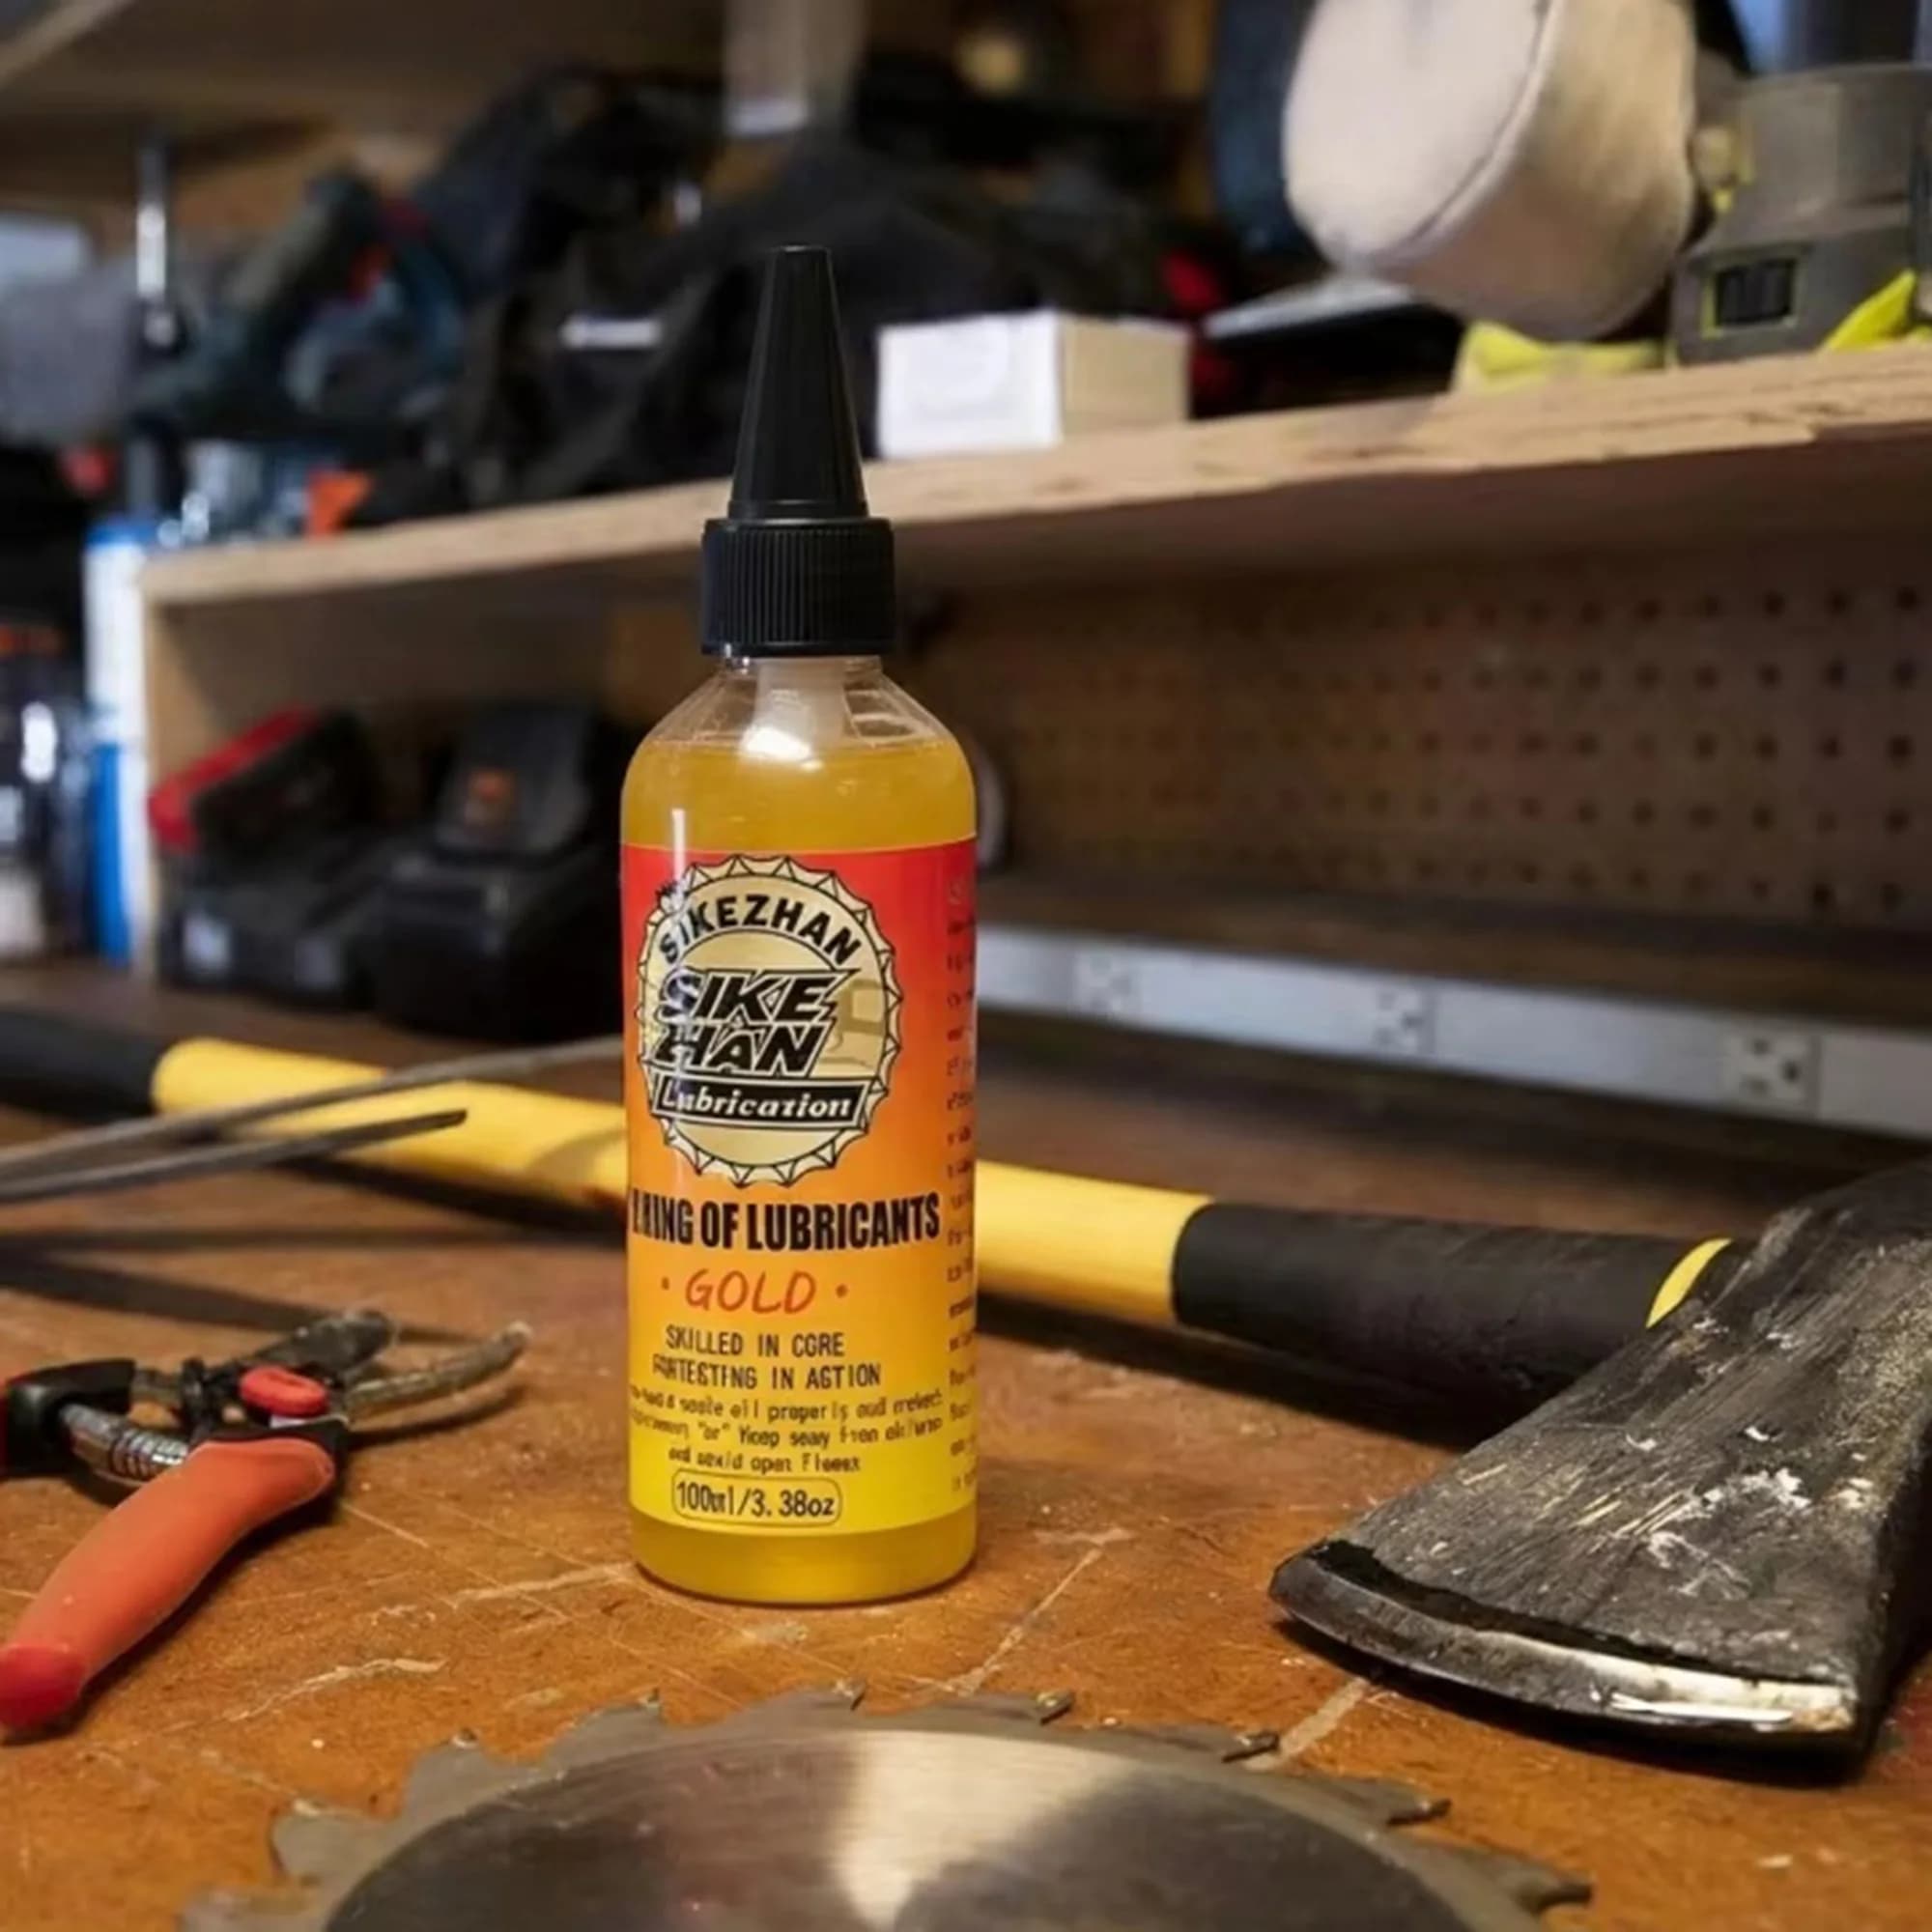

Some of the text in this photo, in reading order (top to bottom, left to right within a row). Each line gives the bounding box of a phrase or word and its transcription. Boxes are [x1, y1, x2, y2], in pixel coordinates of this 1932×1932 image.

[658, 893, 862, 965] SIKEZHAN
[658, 969, 854, 1021] SIKE
[661, 1079, 853, 1119] Lubrication
[700, 1200, 740, 1250] OF
[746, 1192, 941, 1252] LUBRICANTS
[684, 1268, 817, 1315] GOLD
[665, 1323, 744, 1356] SKILLED
[757, 1333, 780, 1357] IN
[772, 1366, 794, 1390] IN
